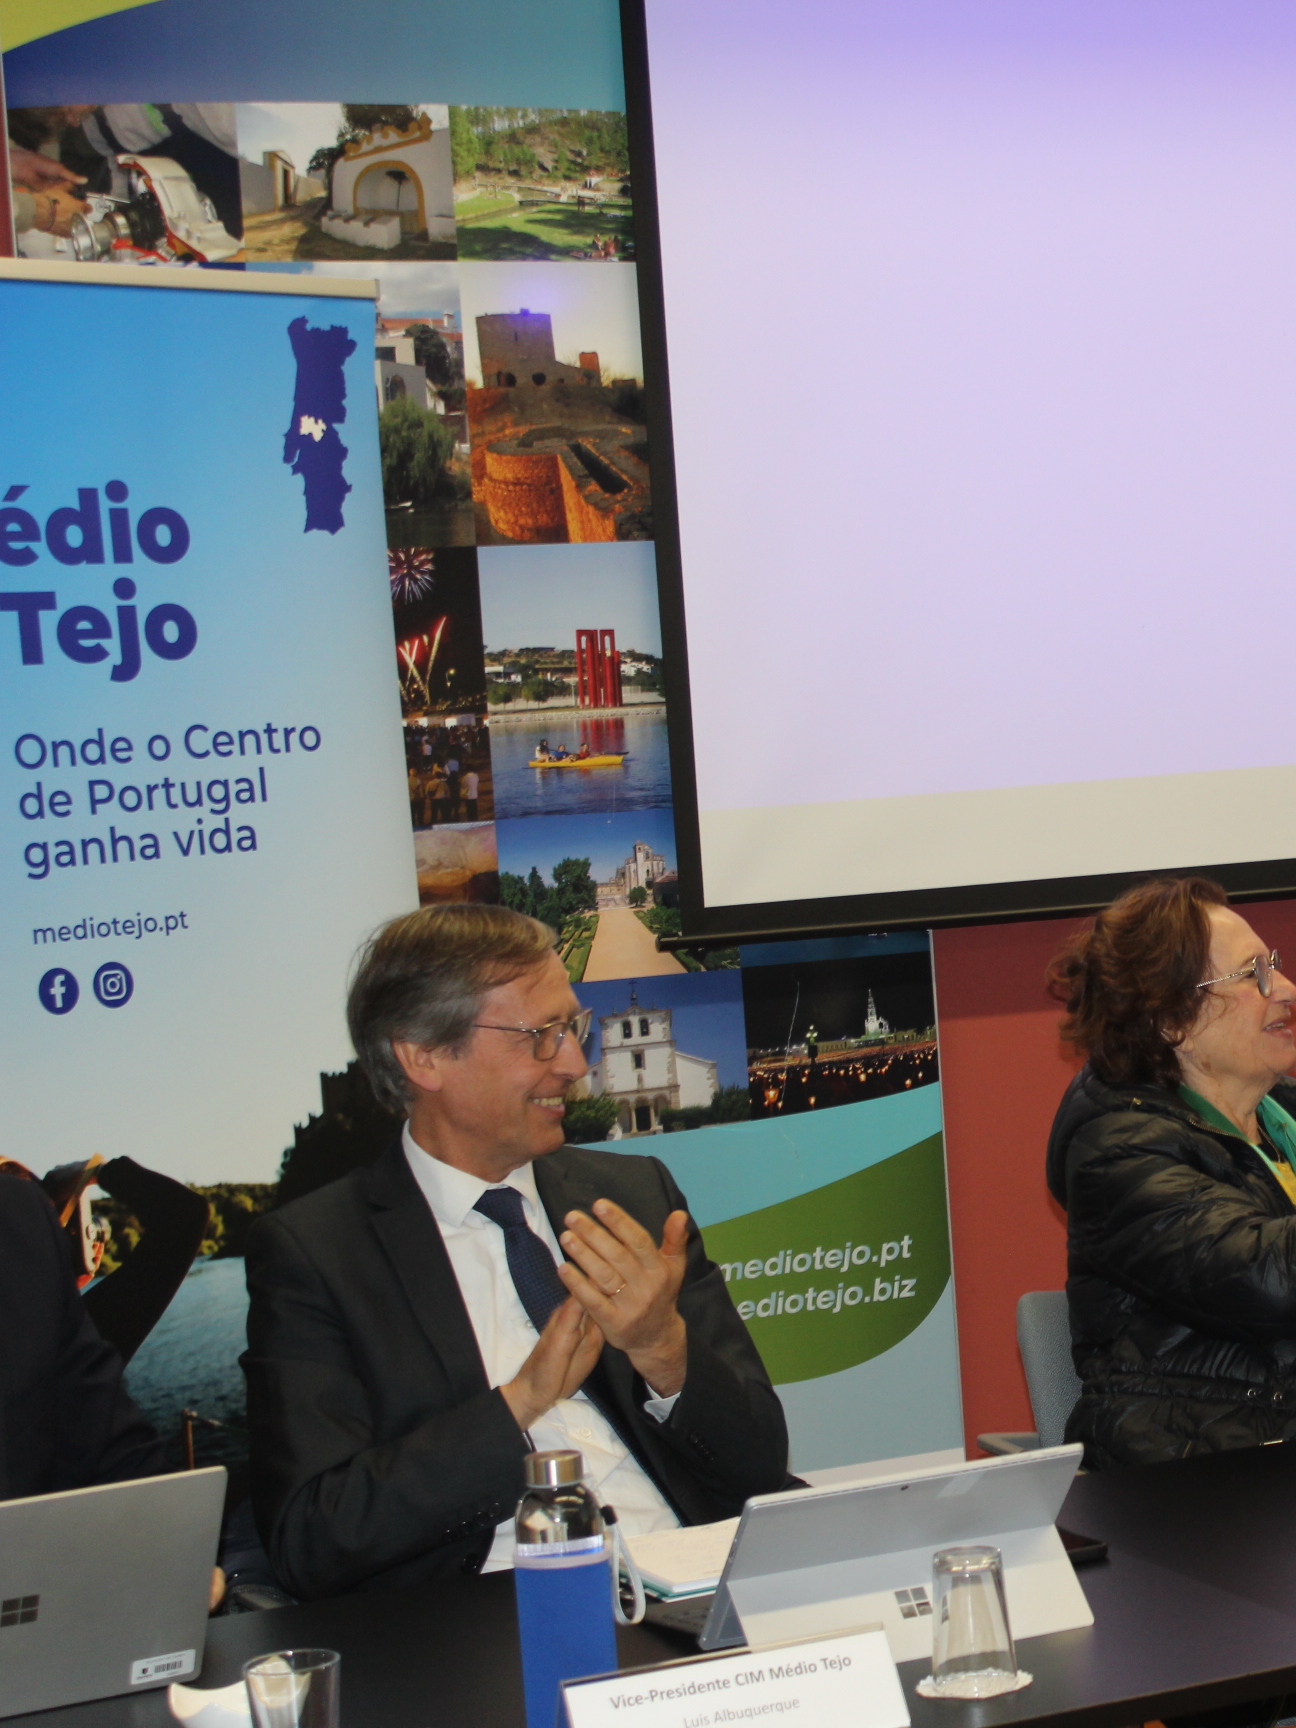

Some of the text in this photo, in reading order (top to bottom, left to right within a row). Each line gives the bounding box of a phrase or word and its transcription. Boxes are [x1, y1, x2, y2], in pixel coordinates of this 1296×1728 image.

[0, 479, 191, 567] édio
[0, 577, 198, 683] Tejo
[15, 721, 322, 769] Onde o Centro
[19, 767, 269, 820] de Portugal
[23, 817, 258, 880] ganha vida
[32, 910, 189, 945] mediotejo.pt
[718, 1234, 913, 1283] mediotejo.pt
[609, 1654, 853, 1710] Vice-Presidente CIM Médio Tejo
[713, 1698, 801, 1725] Albuquerque
